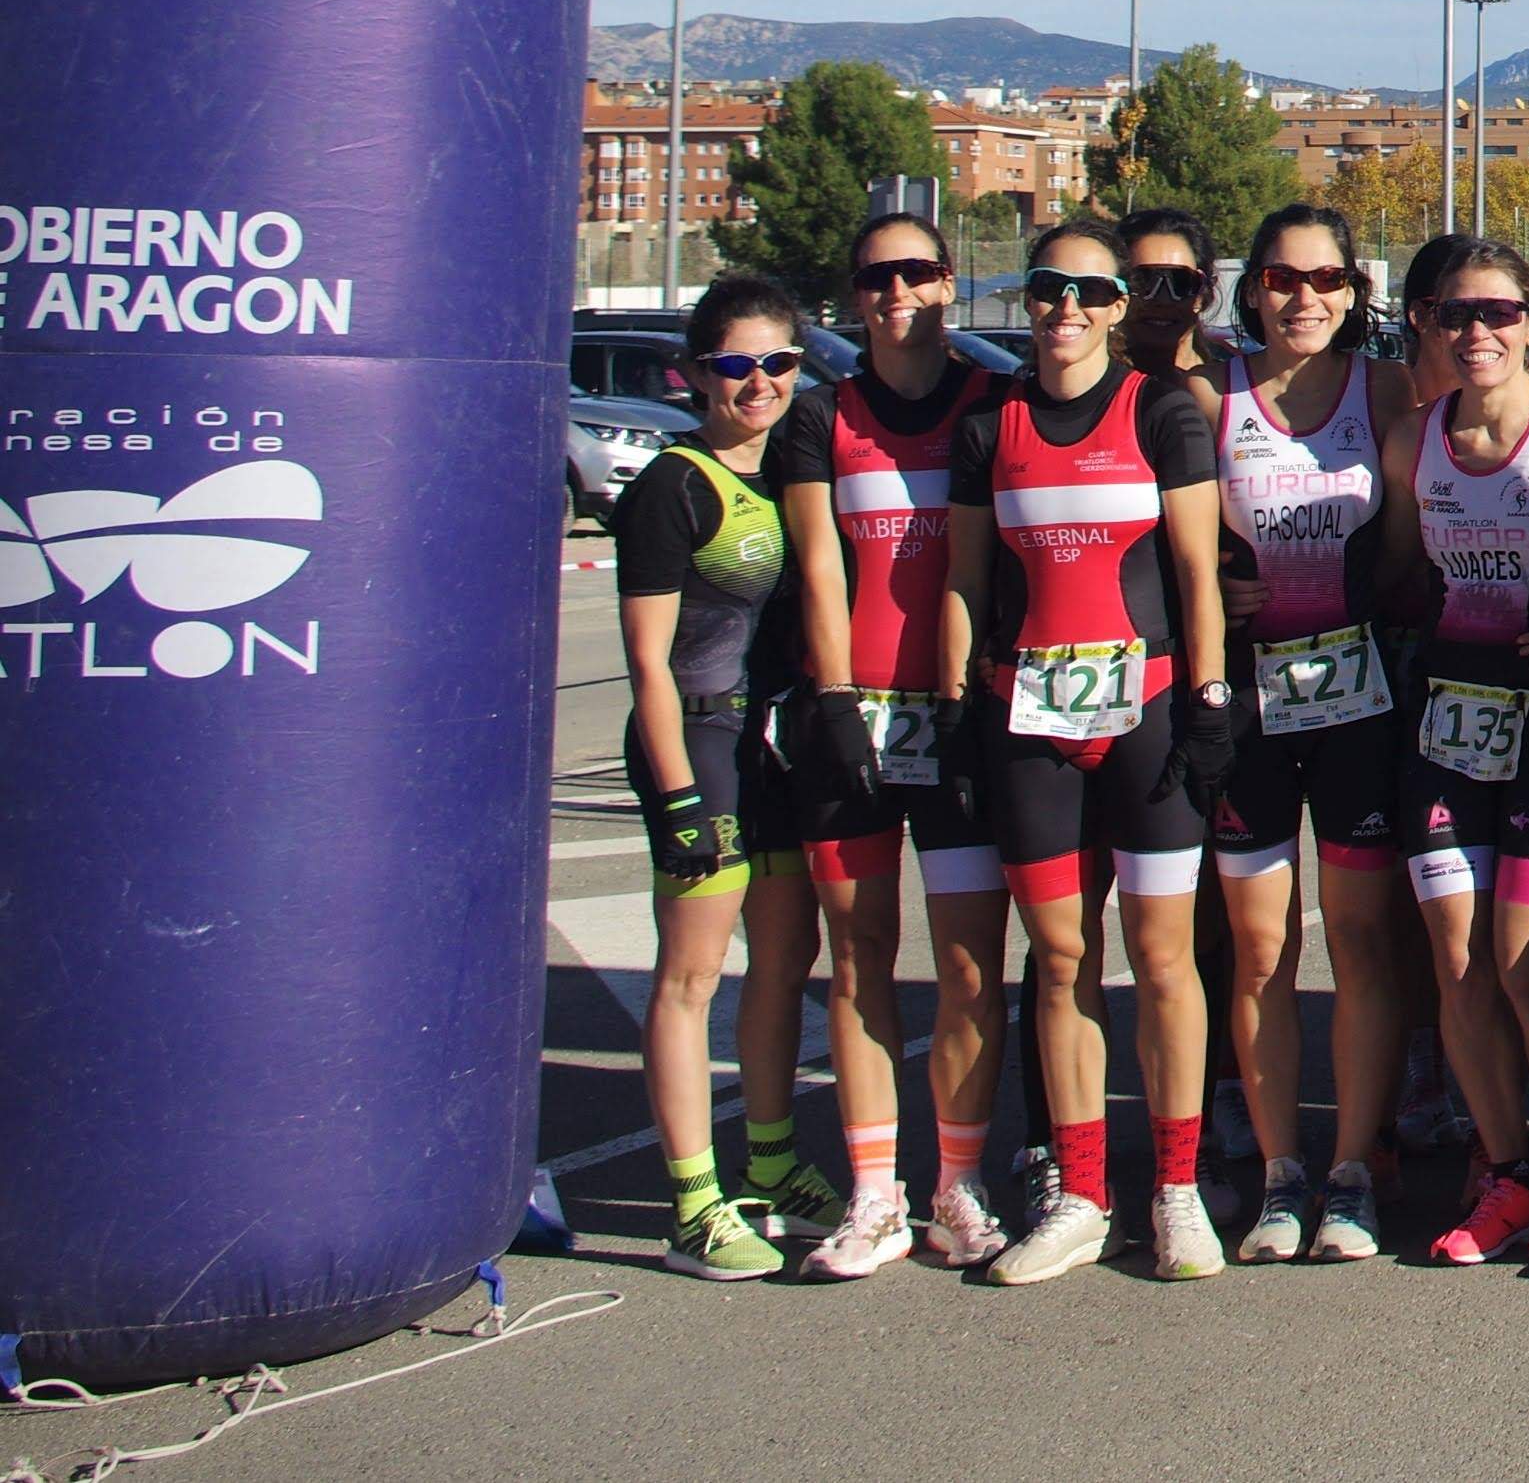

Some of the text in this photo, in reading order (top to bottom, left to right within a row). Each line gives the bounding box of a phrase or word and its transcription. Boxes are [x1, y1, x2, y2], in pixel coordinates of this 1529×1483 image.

[28, 272, 352, 335] ARAGON
[209, 430, 283, 452] de
[1271, 463, 1327, 473] TRIATLON
[1228, 473, 1373, 502] EUROPA
[1018, 527, 1115, 548] E.BERNAL
[1254, 504, 1345, 542] PASCUAL
[1448, 519, 1498, 528] TRIATLON
[891, 542, 923, 559] ESP
[1054, 548, 1081, 563] ESP
[1441, 550, 1522, 581] LUACES
[1037, 662, 1134, 713] 121
[1276, 643, 1369, 707] 127
[1441, 702, 1517, 757] 135
